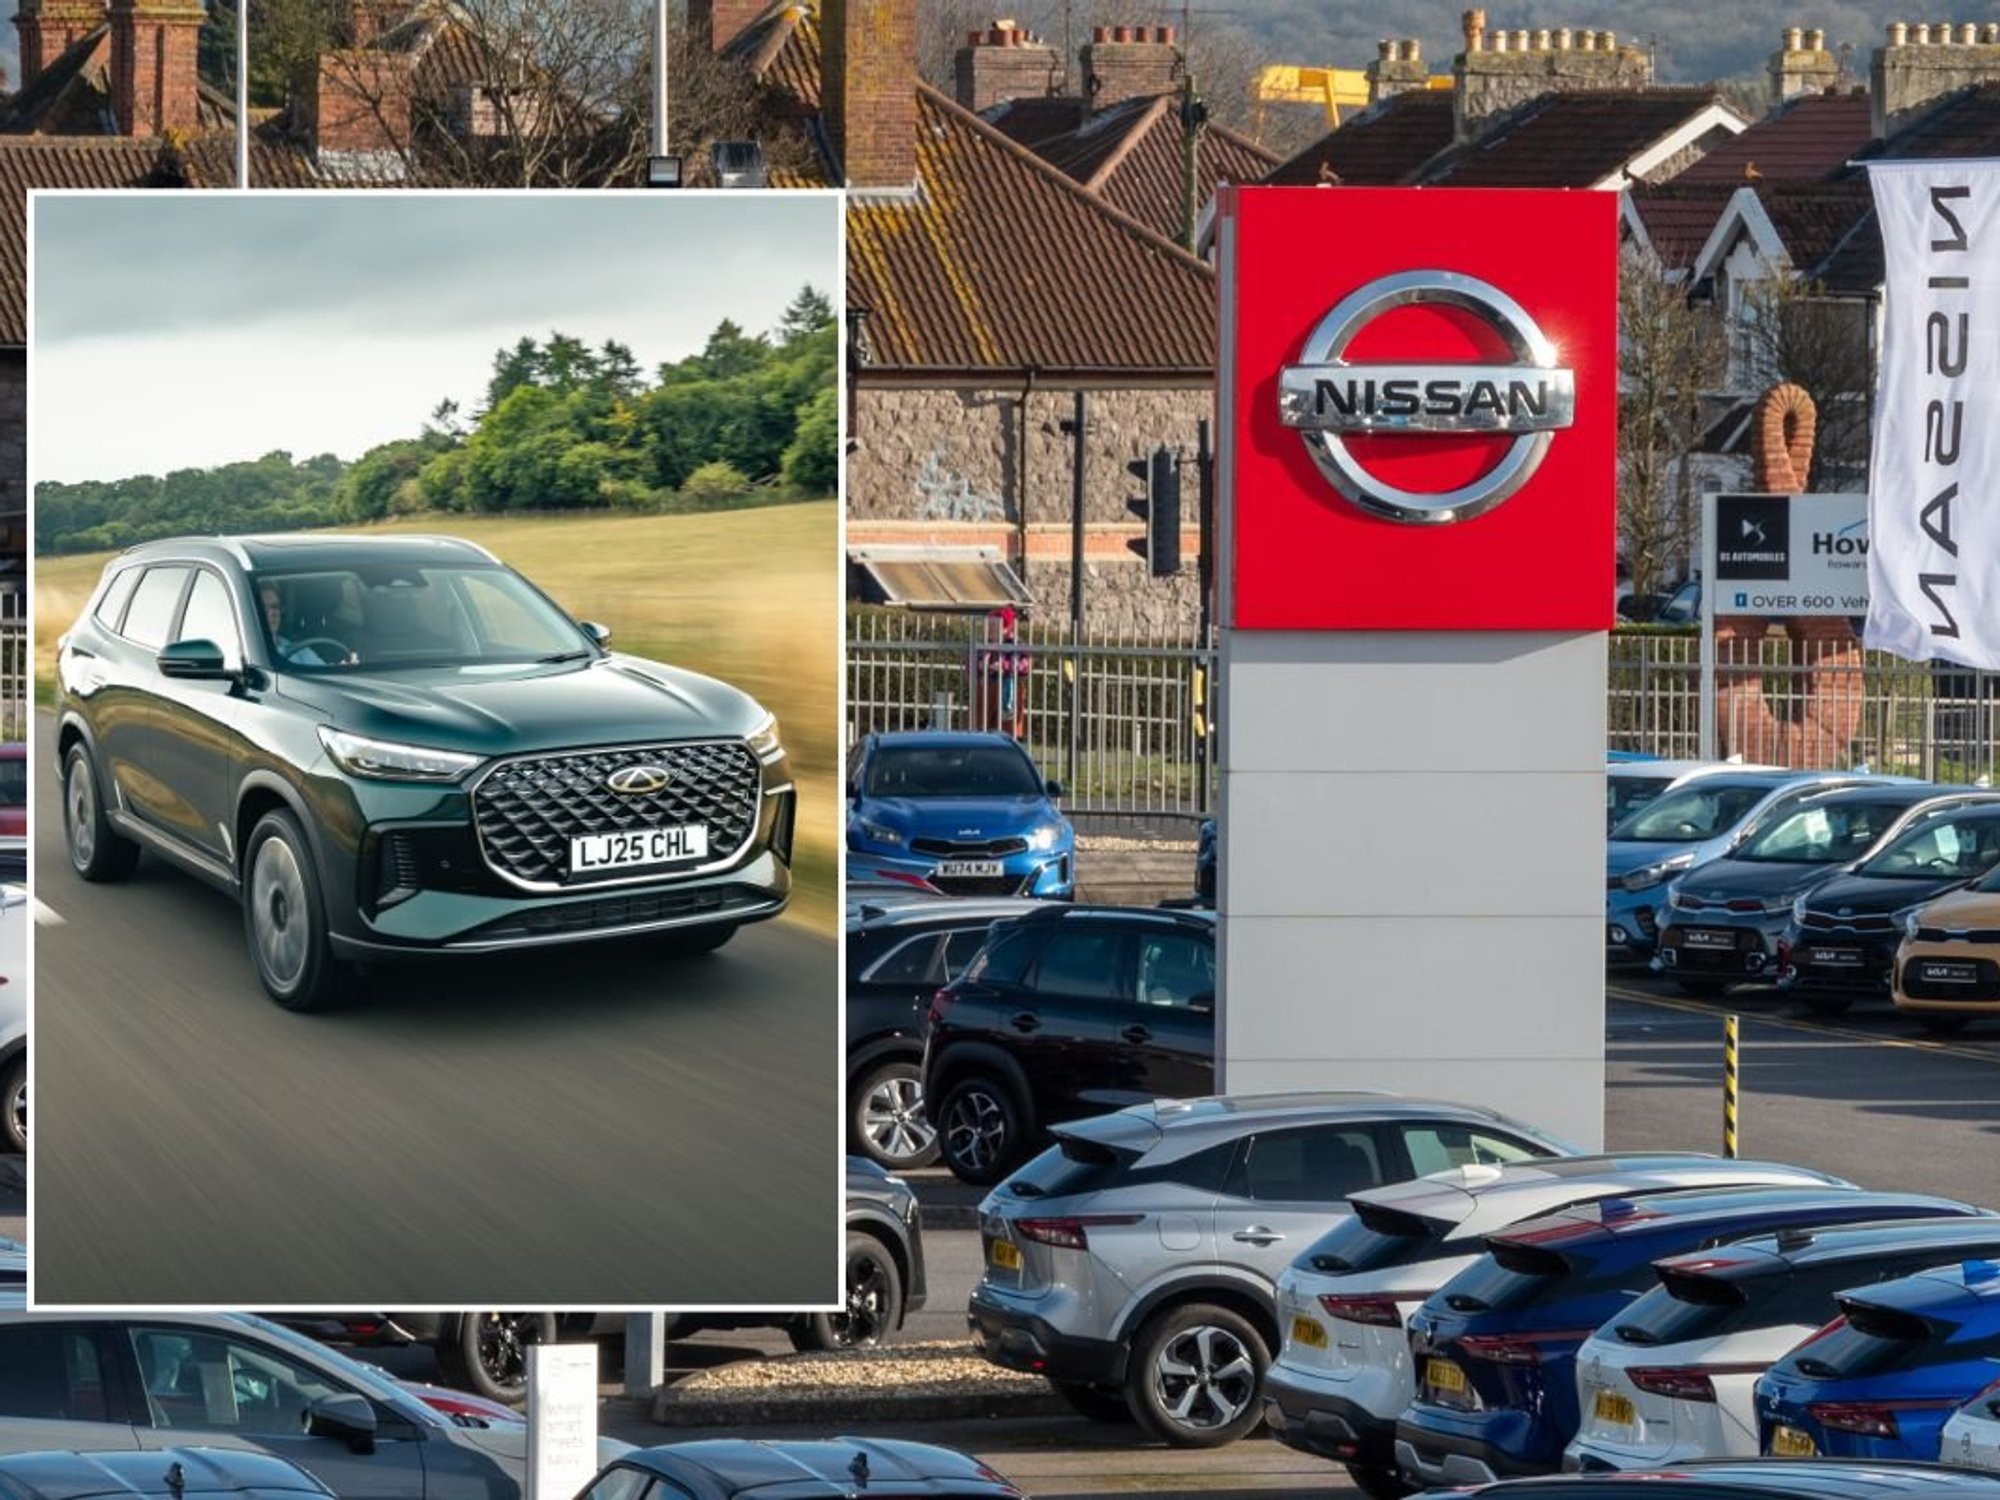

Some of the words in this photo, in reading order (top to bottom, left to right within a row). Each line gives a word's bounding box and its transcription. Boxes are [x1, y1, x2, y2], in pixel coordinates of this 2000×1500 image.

[1315, 379, 1548, 416] NISSAN
[1732, 552, 1786, 562] AUTOMOBILES
[1752, 595, 1797, 608] OVER
[1803, 595, 1834, 608] 600
[581, 835, 644, 867] LJ25
[651, 830, 695, 859] CHL
